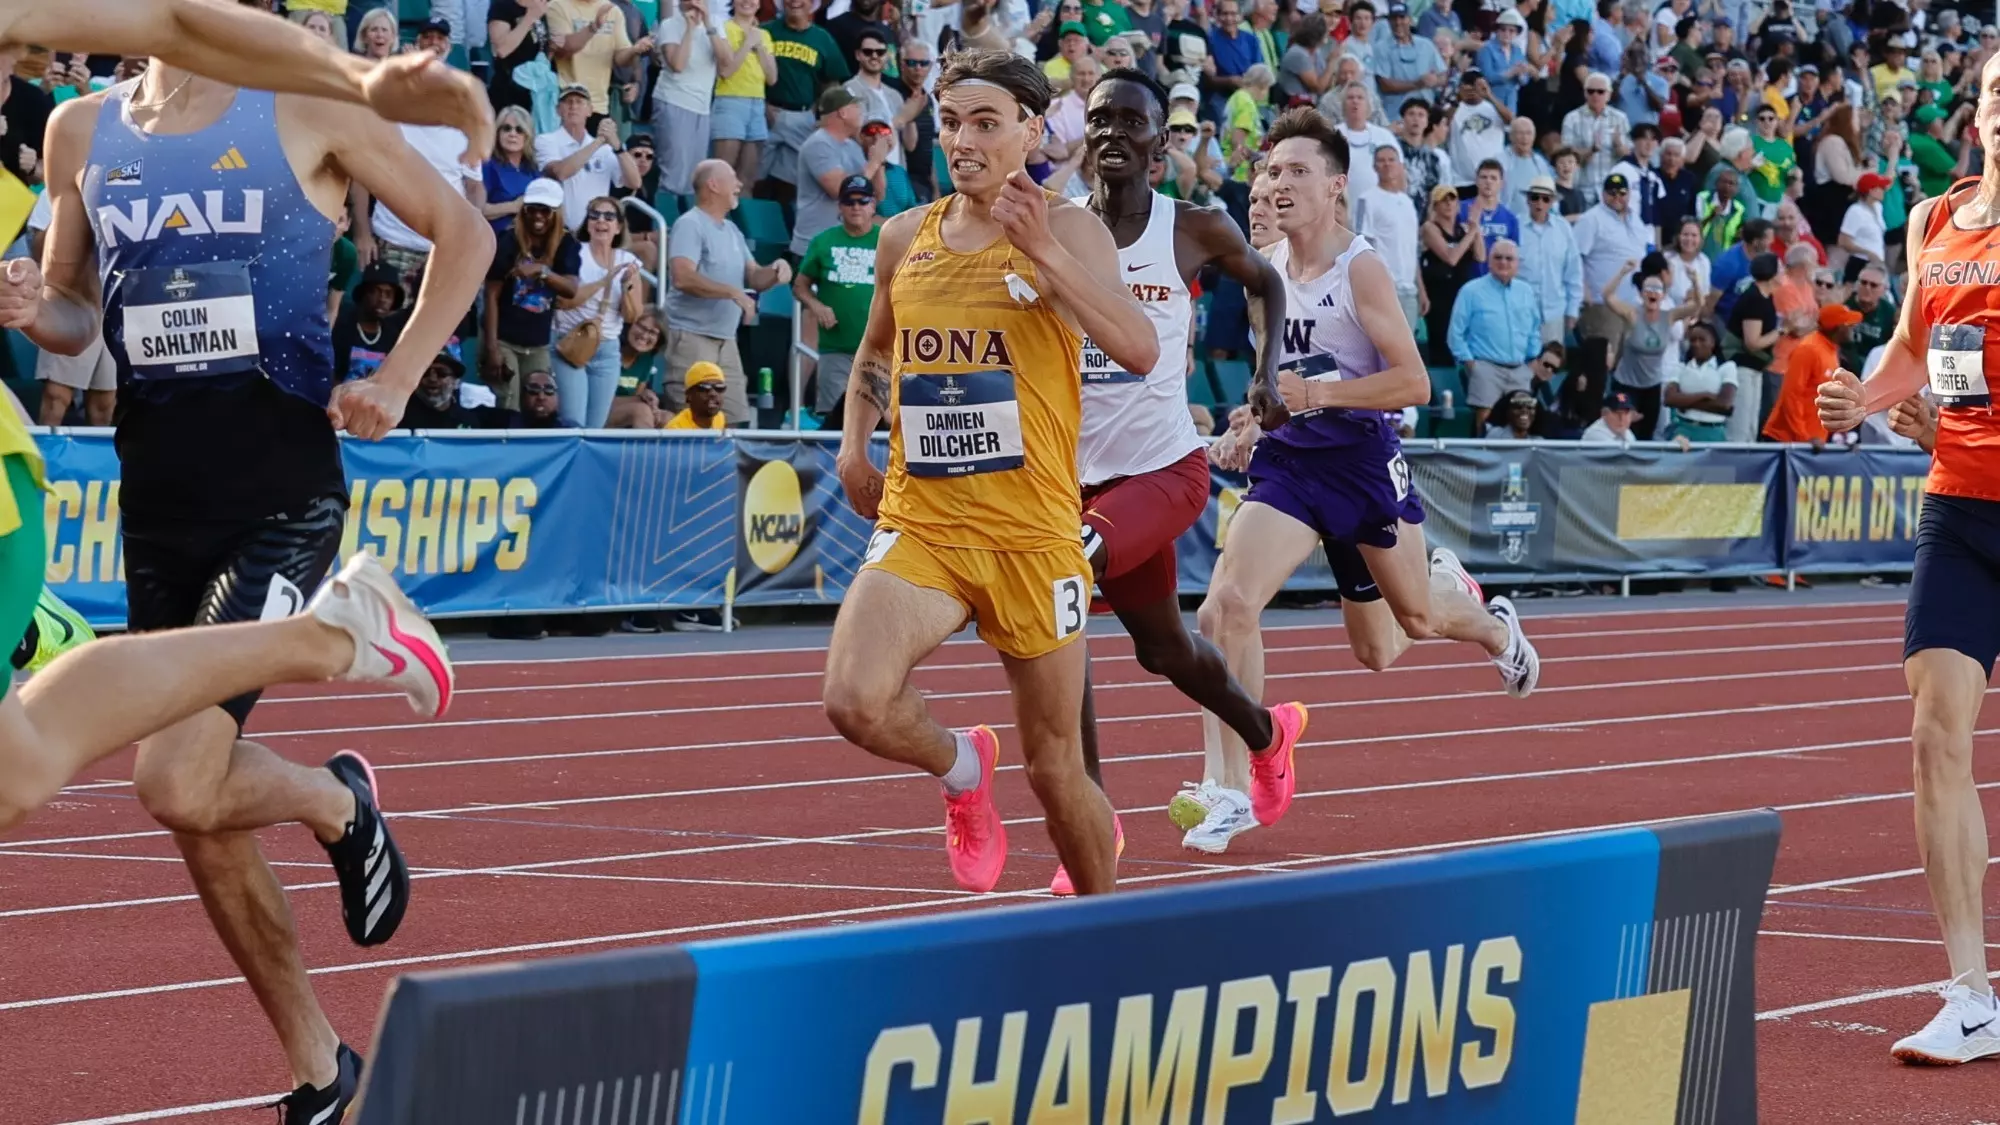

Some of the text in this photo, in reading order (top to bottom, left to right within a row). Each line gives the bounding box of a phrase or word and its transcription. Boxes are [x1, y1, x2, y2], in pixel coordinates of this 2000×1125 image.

[97, 188, 264, 249] NAU
[1925, 260, 2000, 288] IRGINI
[1127, 283, 1171, 302] ATE
[161, 306, 208, 329] COLIN
[141, 328, 238, 358] SAHLMAN
[900, 327, 1015, 366] IONA
[1283, 318, 1316, 354] W
[1085, 353, 1111, 368] ROP
[1941, 356, 1956, 370] WES
[1936, 374, 1969, 391] PORTER
[925, 411, 985, 431] DAMIEN
[919, 431, 1001, 457] DILCHER
[1393, 456, 1408, 495] 8
[1795, 475, 1862, 542] NCAA
[1869, 475, 1896, 541] DI
[1062, 579, 1081, 635] 3
[858, 935, 1523, 1125] CHAMPIONS
